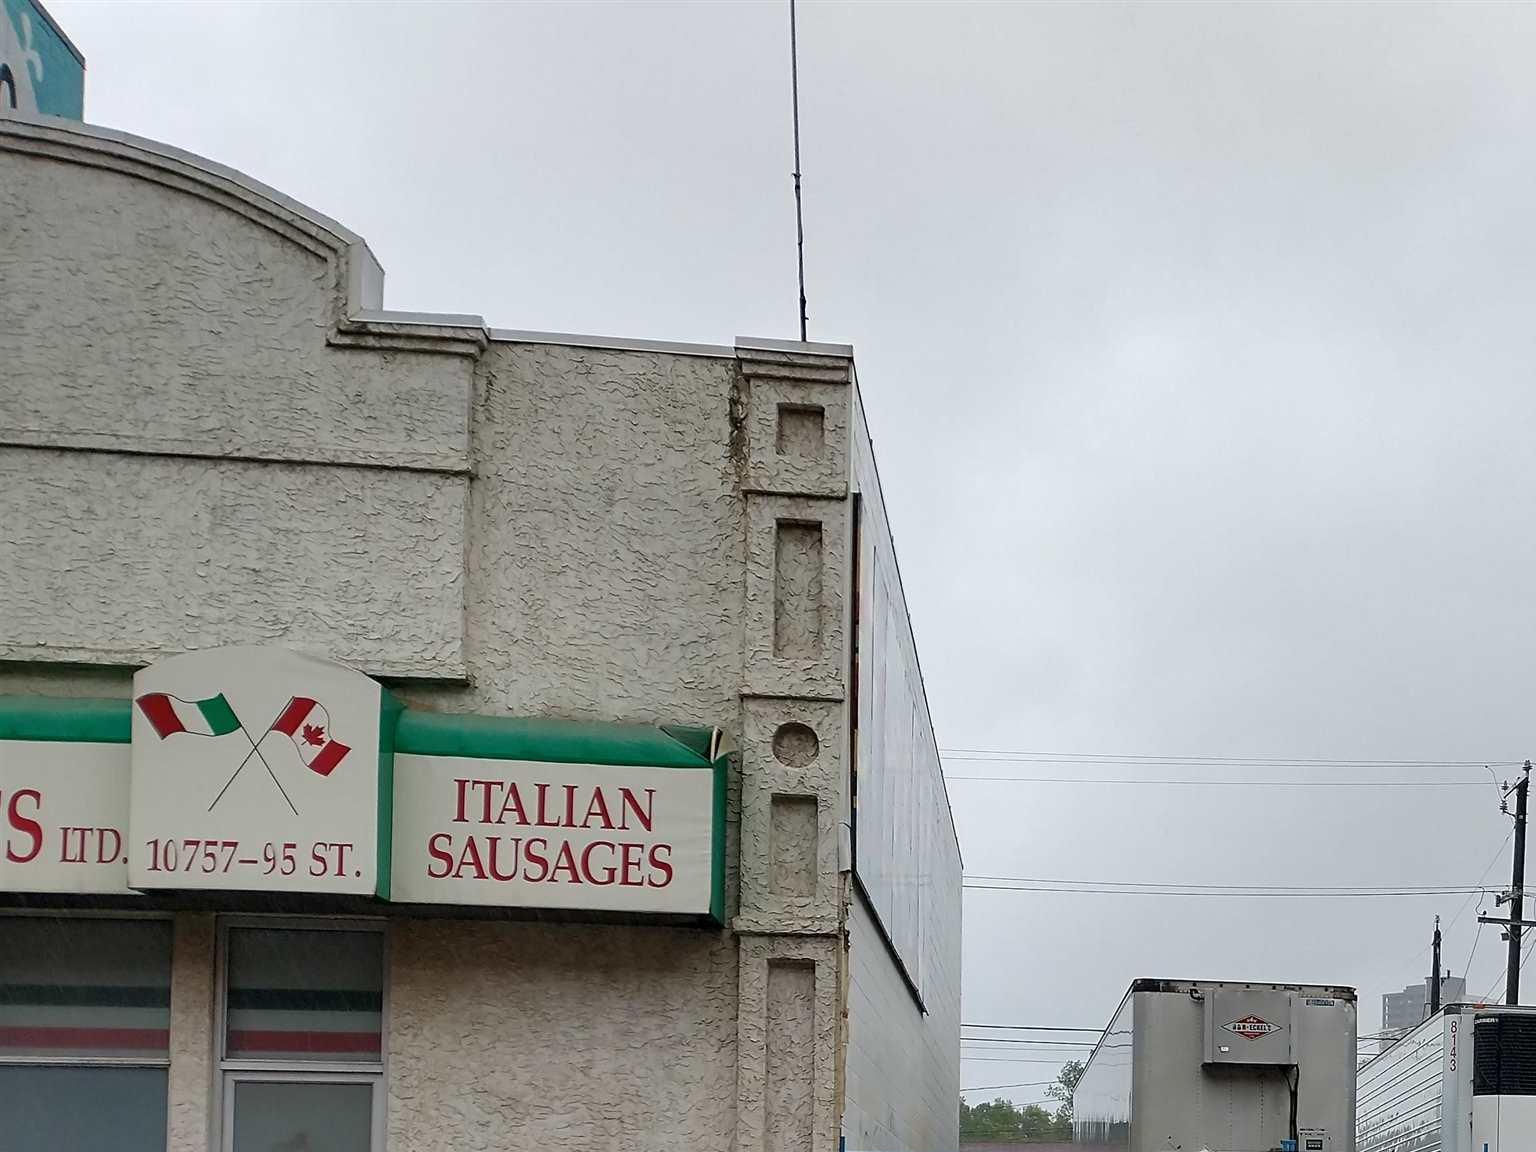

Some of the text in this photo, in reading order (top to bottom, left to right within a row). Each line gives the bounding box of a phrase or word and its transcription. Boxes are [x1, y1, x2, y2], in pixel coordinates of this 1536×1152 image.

[452, 779, 656, 832] ITALIAN
[59, 826, 129, 864] LTD.
[309, 841, 361, 877] ST.
[427, 833, 673, 888] SAUSAGES
